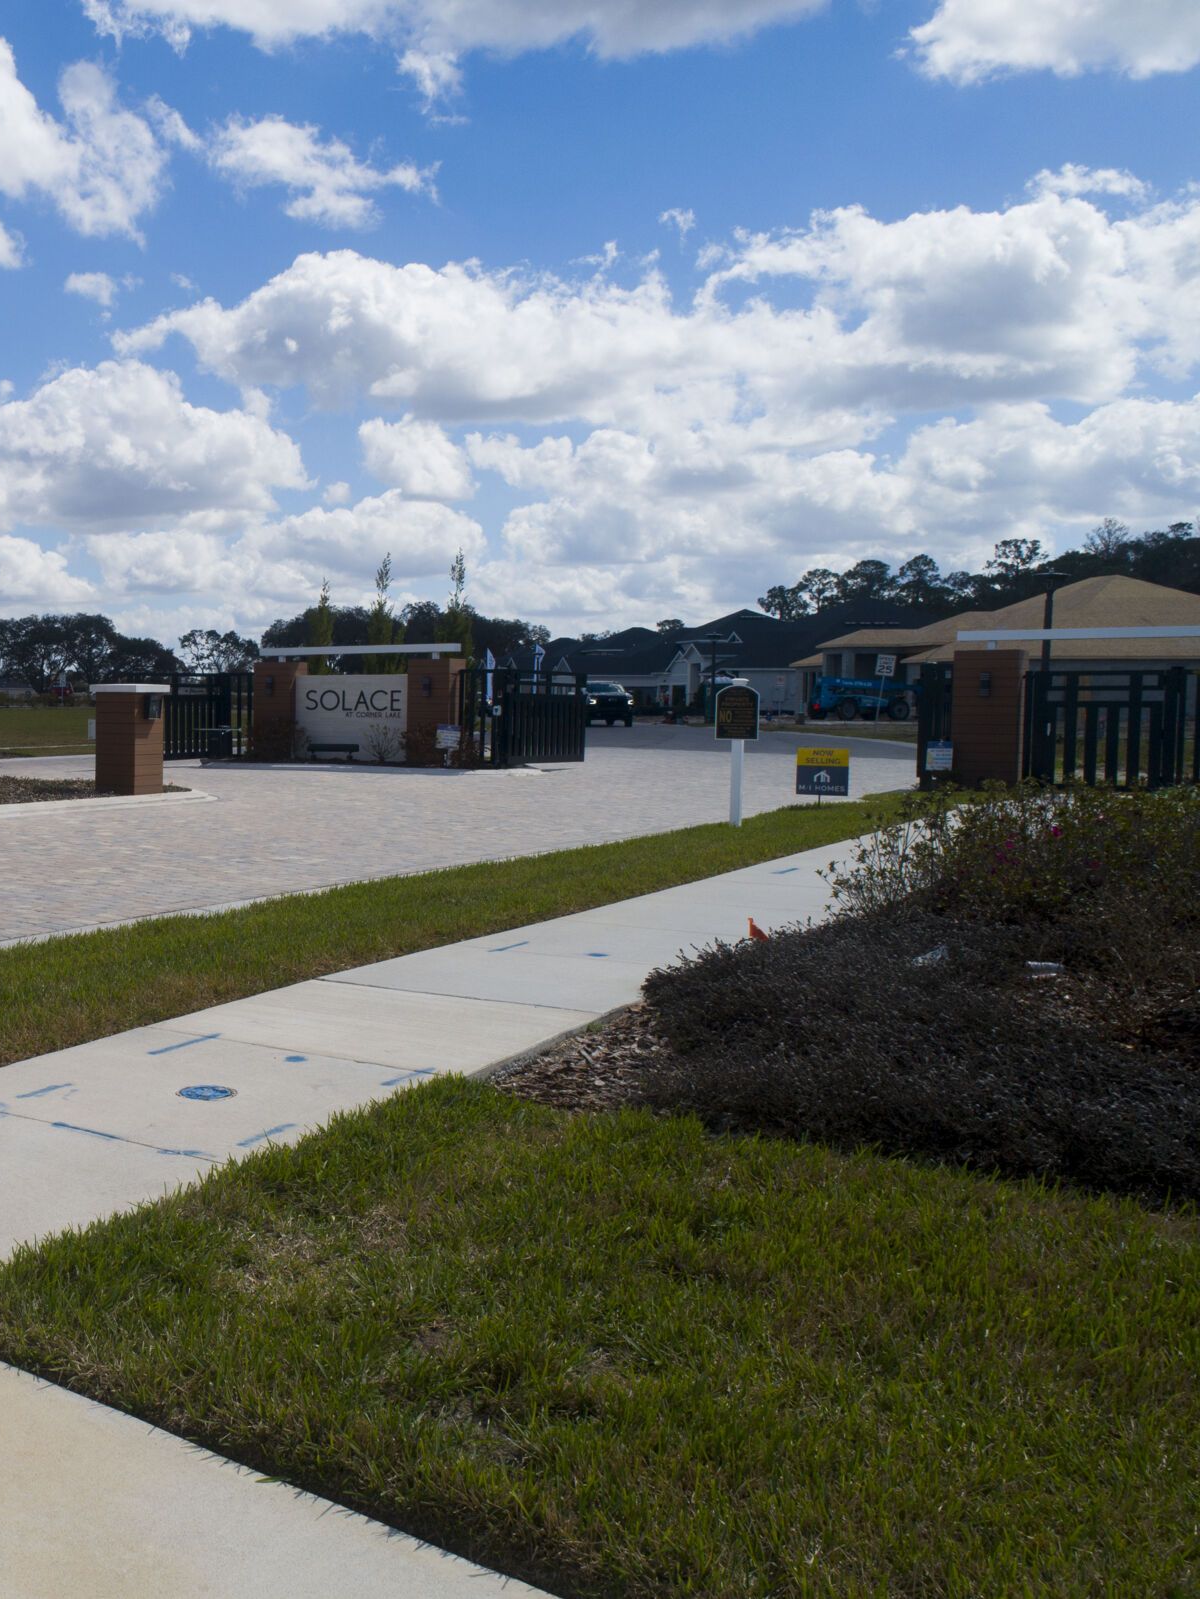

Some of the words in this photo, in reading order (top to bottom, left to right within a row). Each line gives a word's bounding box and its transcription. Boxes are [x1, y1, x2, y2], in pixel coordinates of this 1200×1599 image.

[878, 665, 893, 674] 25
[305, 690, 402, 711] SOLACE
[719, 710, 733, 723] NO
